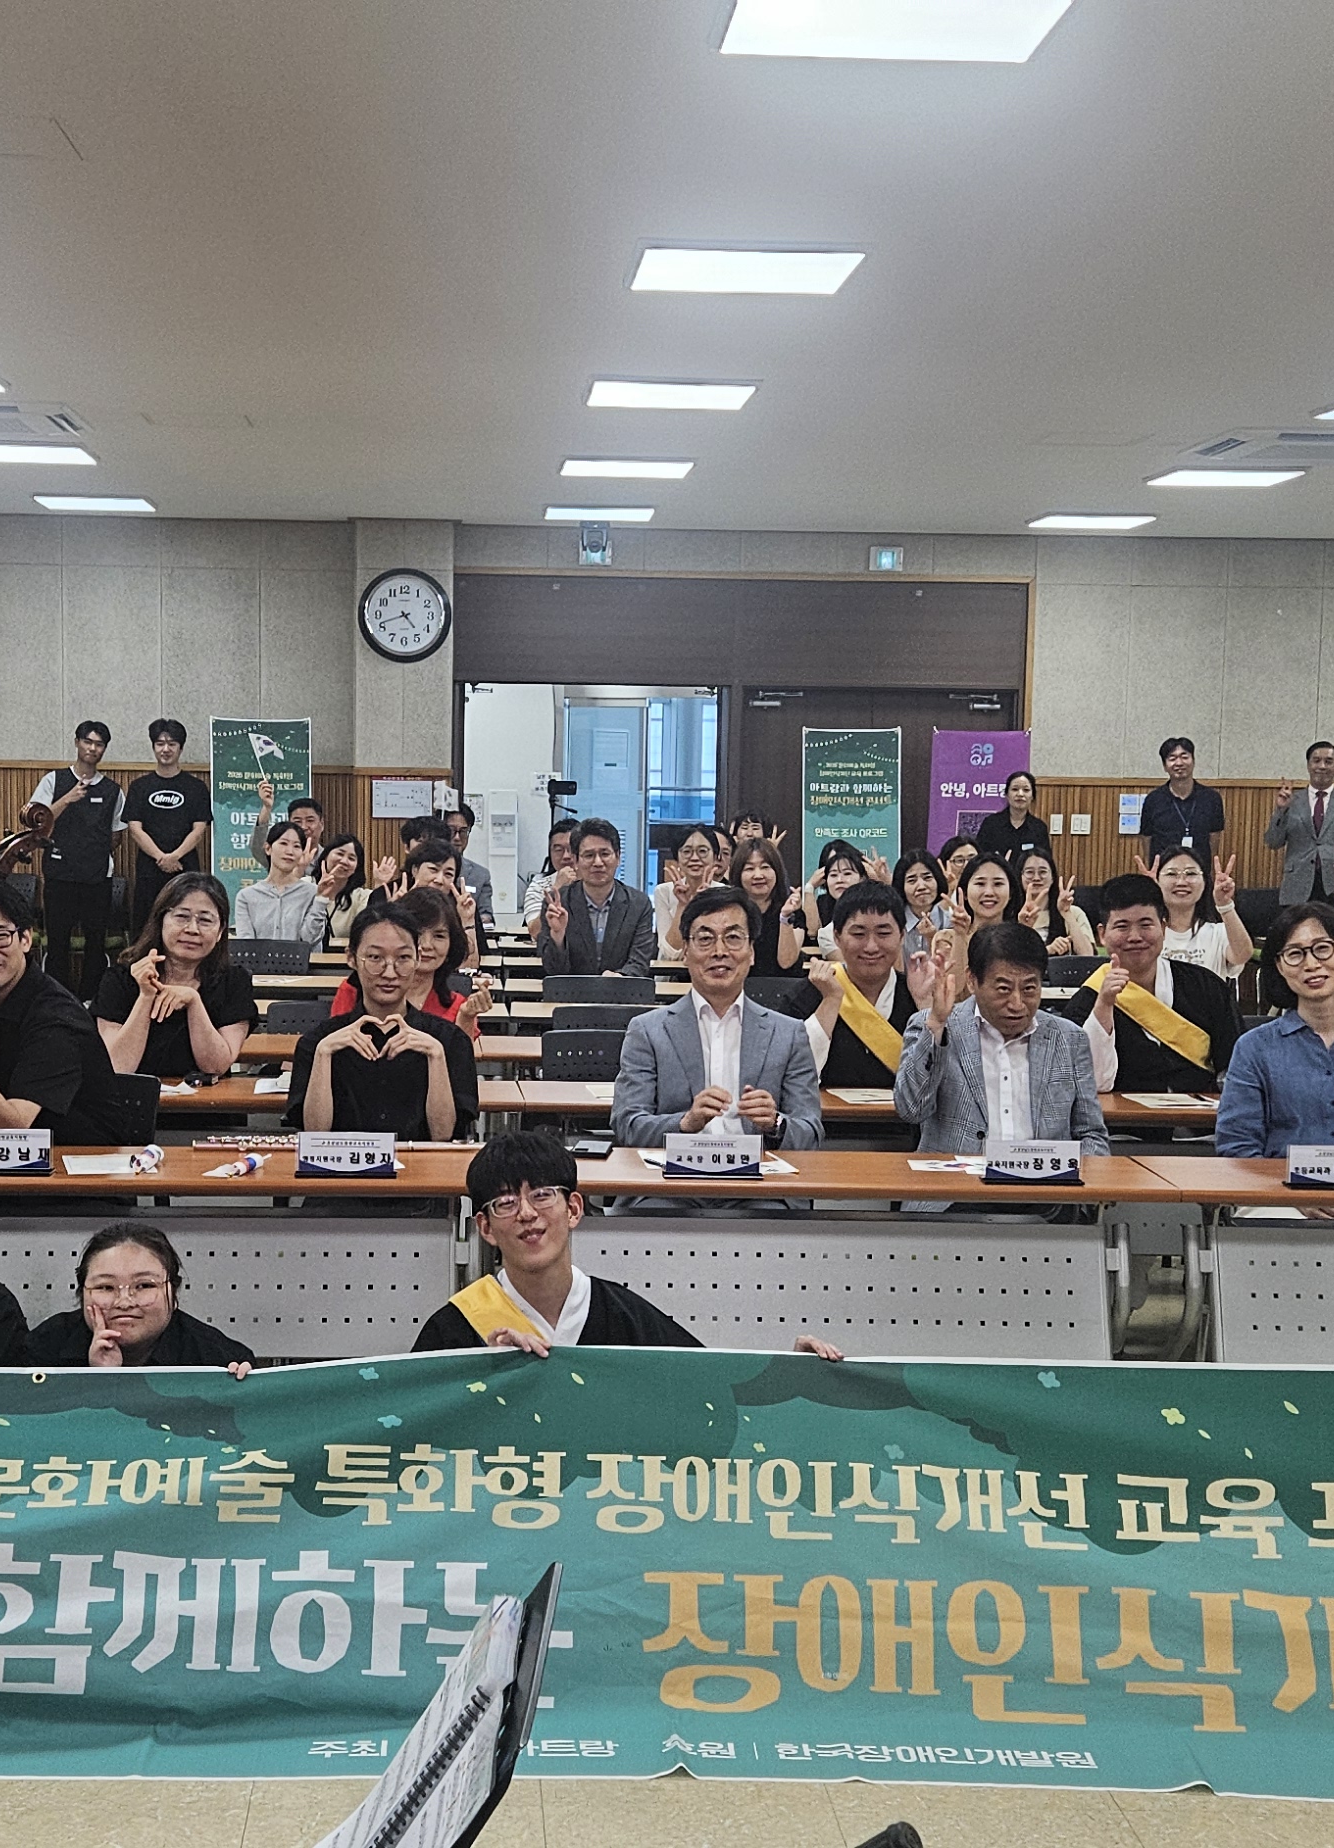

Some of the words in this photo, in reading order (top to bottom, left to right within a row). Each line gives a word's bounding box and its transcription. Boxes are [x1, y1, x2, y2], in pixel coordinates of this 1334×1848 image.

[388, 588, 397, 598] 11
[399, 585, 410, 595] 12
[379, 598, 388, 607] 10
[423, 599, 431, 608] 2
[374, 610, 382, 620] 9
[427, 611, 435, 621] 3
[378, 622, 386, 632] 8
[423, 624, 430, 633] 4
[388, 633, 396, 642] 7
[400, 637, 408, 646] 6
[413, 633, 421, 643] 5
[940, 782, 970, 799] 안녕,
[841, 829, 858, 838] 조사
[858, 828, 888, 838] QR코드
[314, 1443, 567, 1530] 특화형
[586, 1453, 1090, 1551] 장애인식개선
[1115, 1473, 1285, 1560] 교육
[307, 1740, 388, 1758] 주최
[774, 1742, 1099, 1770] 한국장애인개발원
